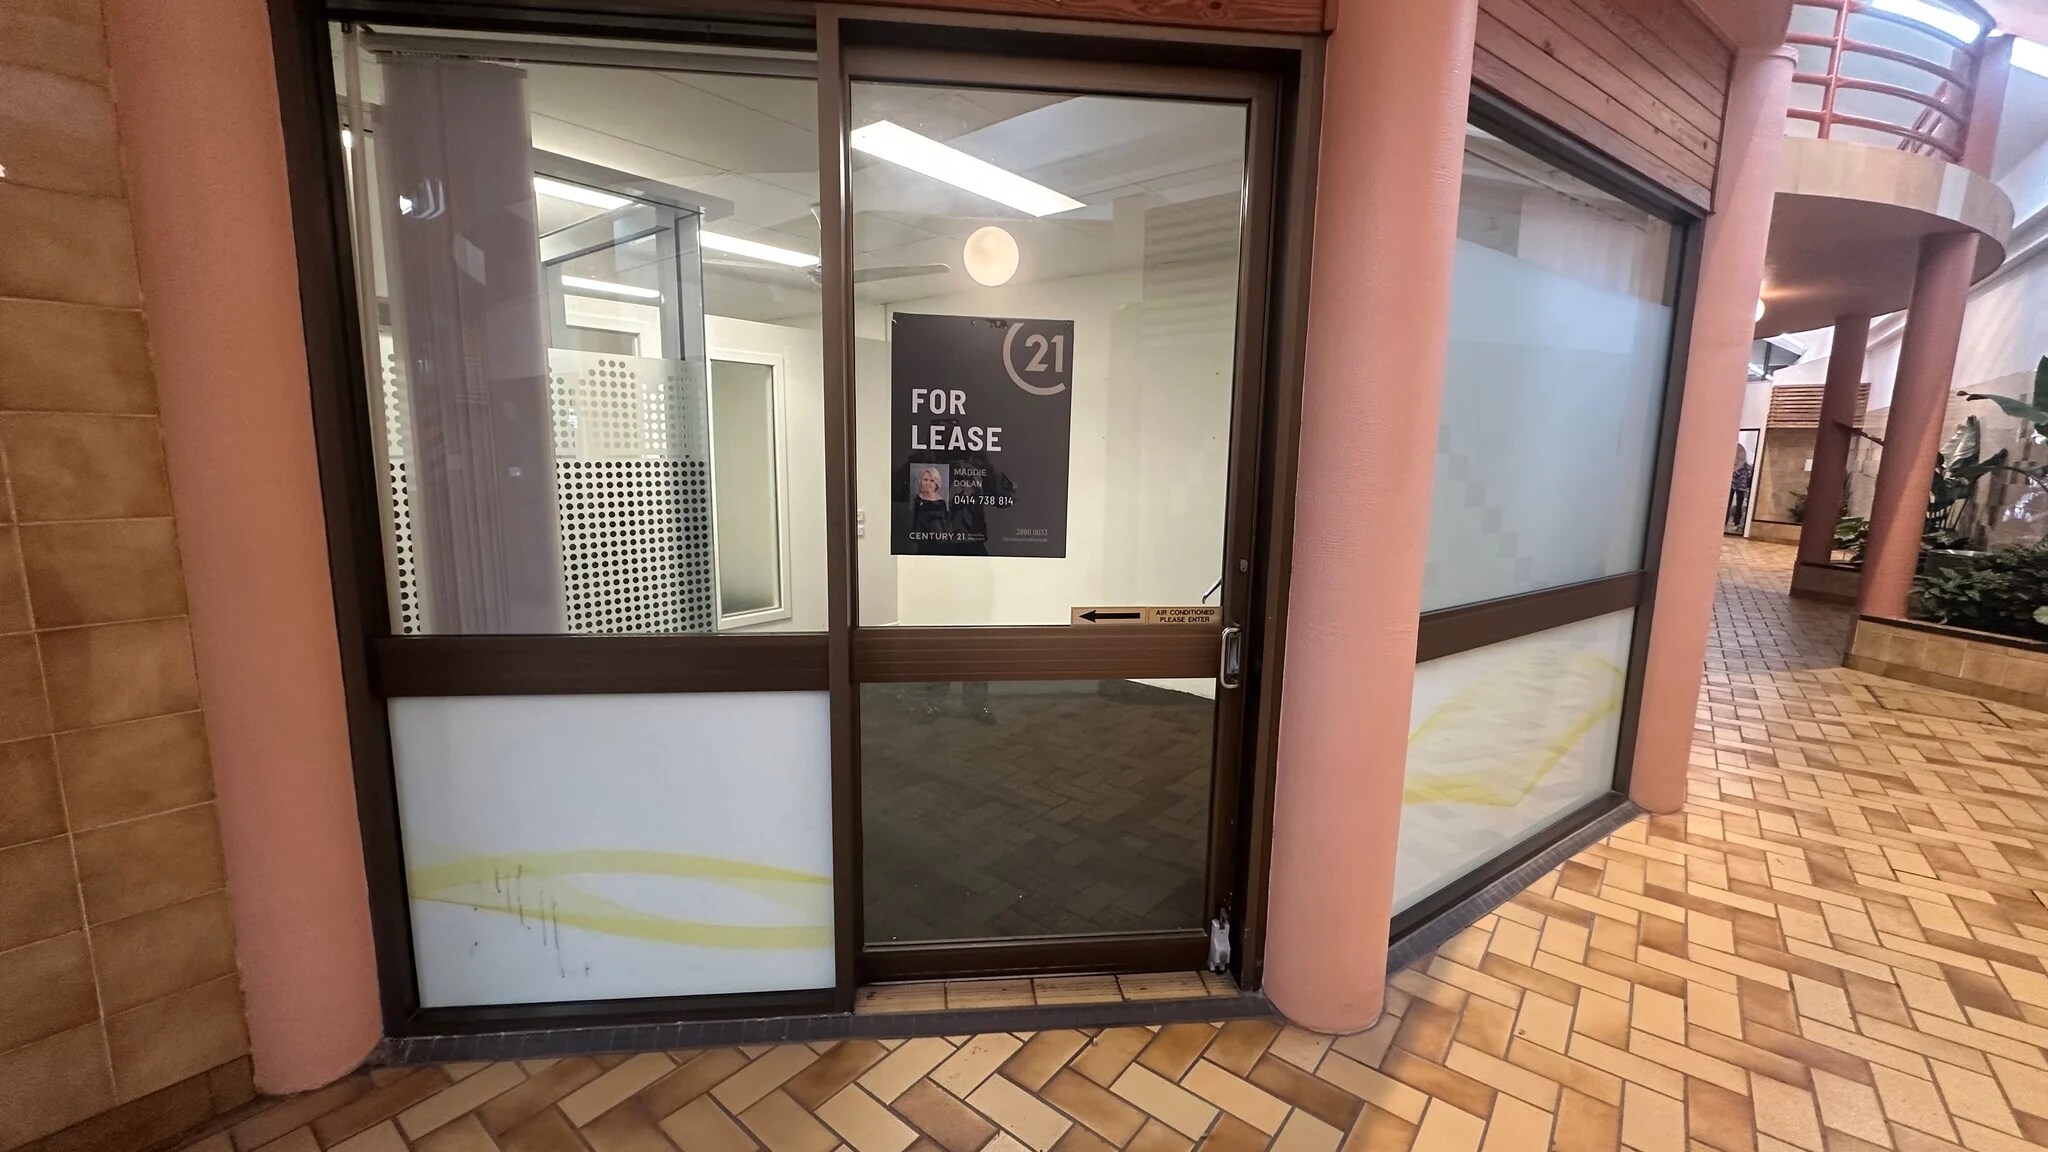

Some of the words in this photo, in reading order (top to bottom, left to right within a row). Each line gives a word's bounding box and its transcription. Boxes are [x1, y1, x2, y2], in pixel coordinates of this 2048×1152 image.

[912, 388, 966, 415] FOR
[912, 424, 1002, 452] LEASE
[953, 468, 987, 477] MADDIE
[953, 479, 983, 488] DOLAN
[954, 495, 975, 505] 0414
[978, 495, 996, 505] 738
[998, 496, 1014, 506] 814
[909, 532, 955, 540] CENTURY
[956, 532, 965, 541] 21
